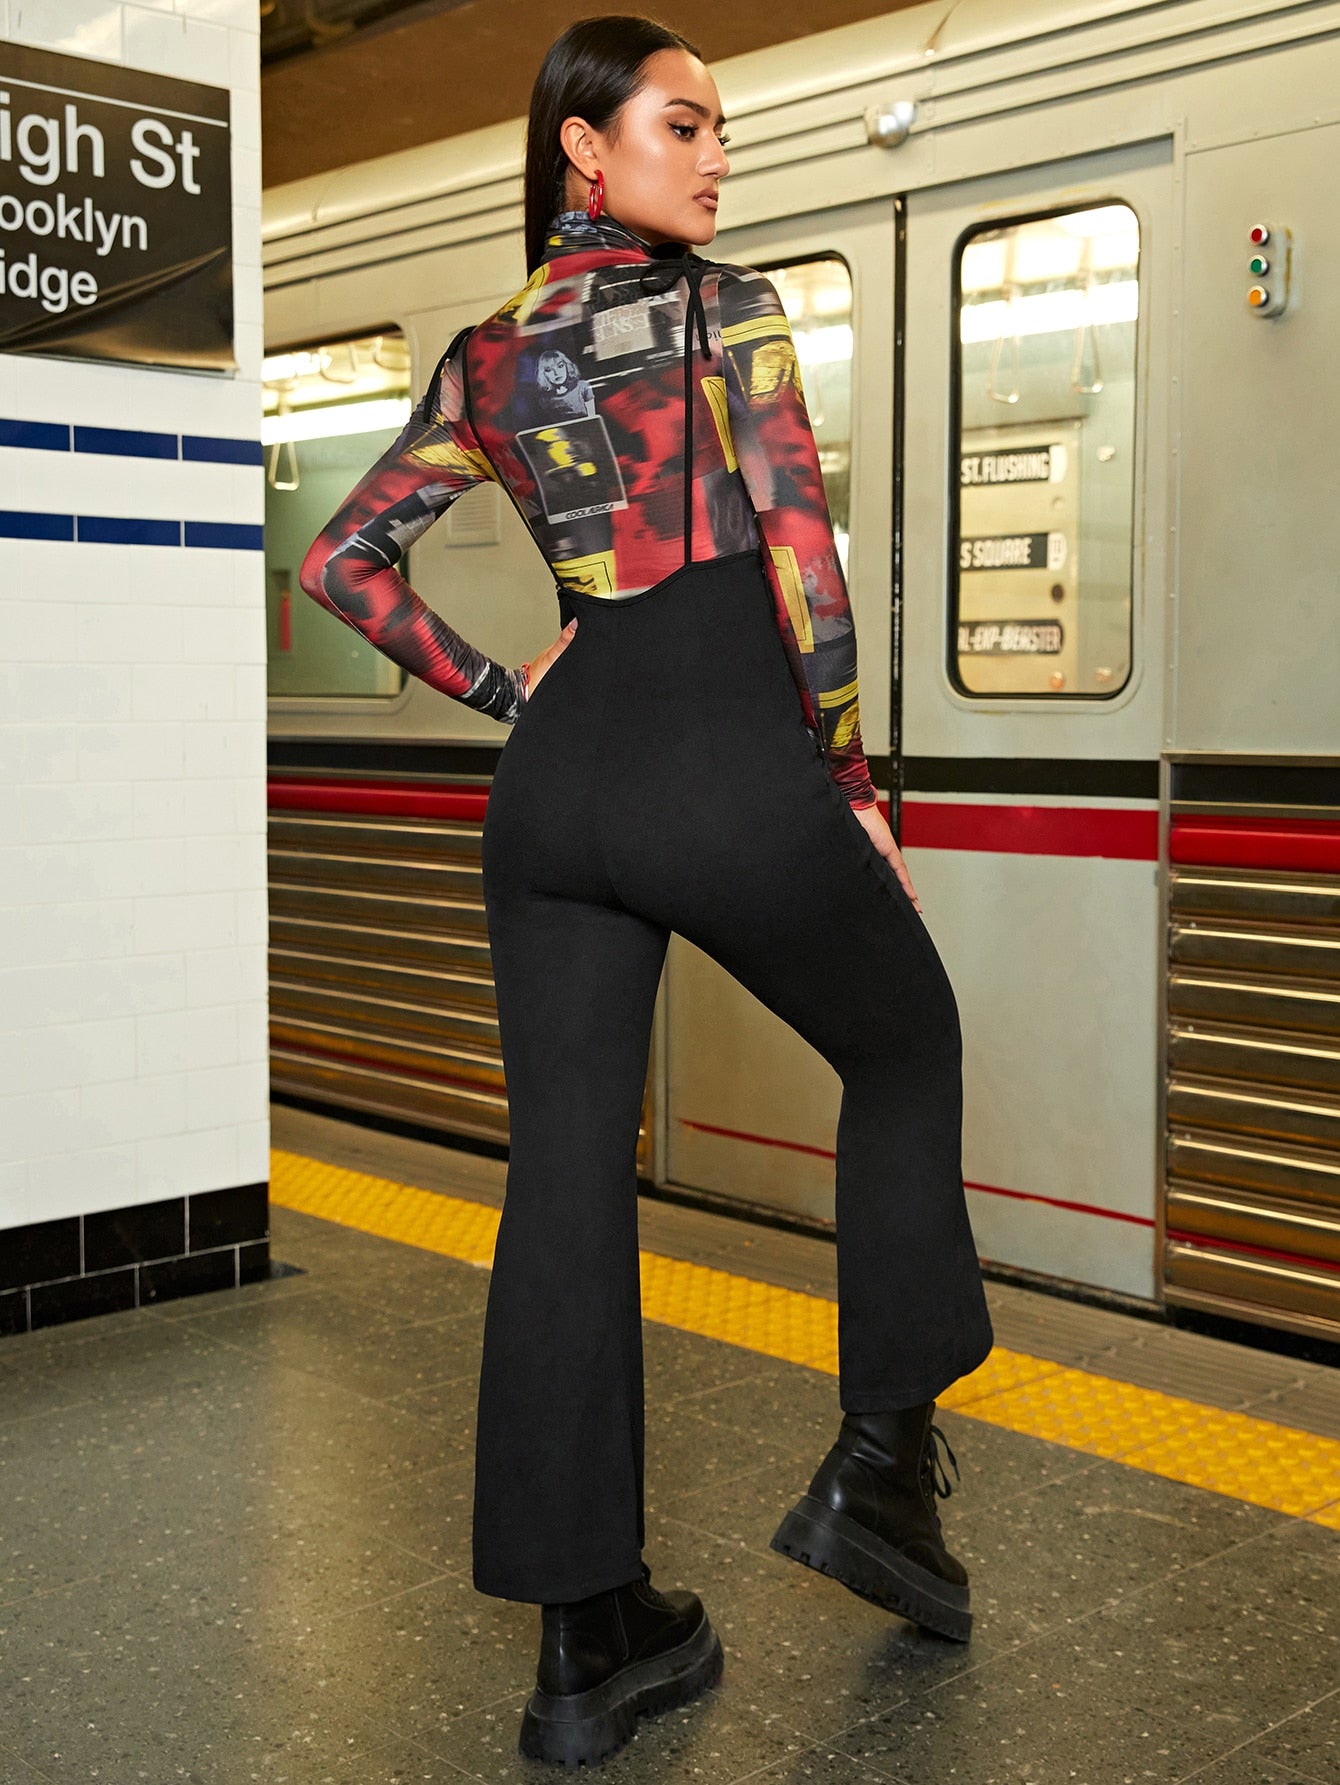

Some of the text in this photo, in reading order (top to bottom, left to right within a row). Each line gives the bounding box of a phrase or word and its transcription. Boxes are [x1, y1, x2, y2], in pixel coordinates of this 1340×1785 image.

[130, 118, 200, 195] St
[0, 193, 148, 256] ooklyn
[972, 537, 1032, 567] SQUARE
